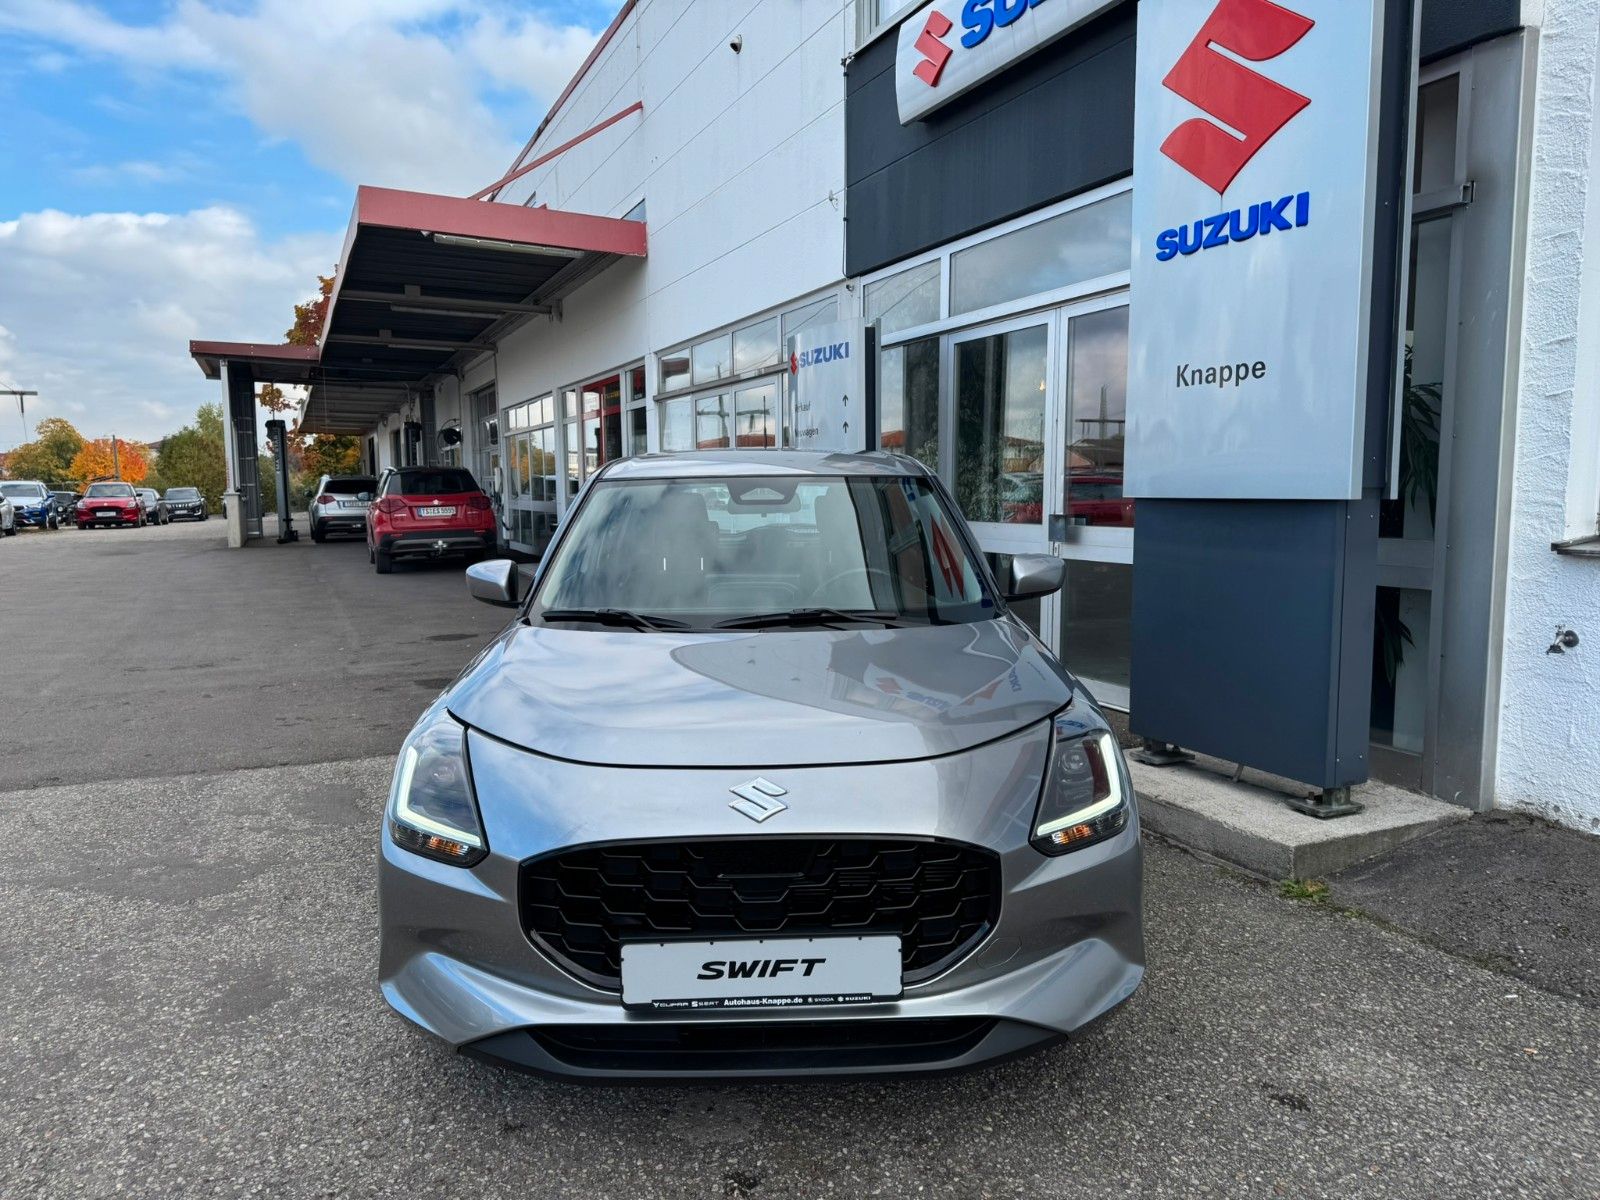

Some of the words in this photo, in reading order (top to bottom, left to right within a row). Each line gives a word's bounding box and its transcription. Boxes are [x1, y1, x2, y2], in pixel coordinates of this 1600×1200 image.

[1155, 191, 1310, 262] SUZUKI
[799, 341, 850, 369] SUZUKI
[1176, 360, 1267, 388] Knappe
[696, 958, 826, 980] SWIFT
[723, 997, 803, 1006] Autohaus-Knappe.de
